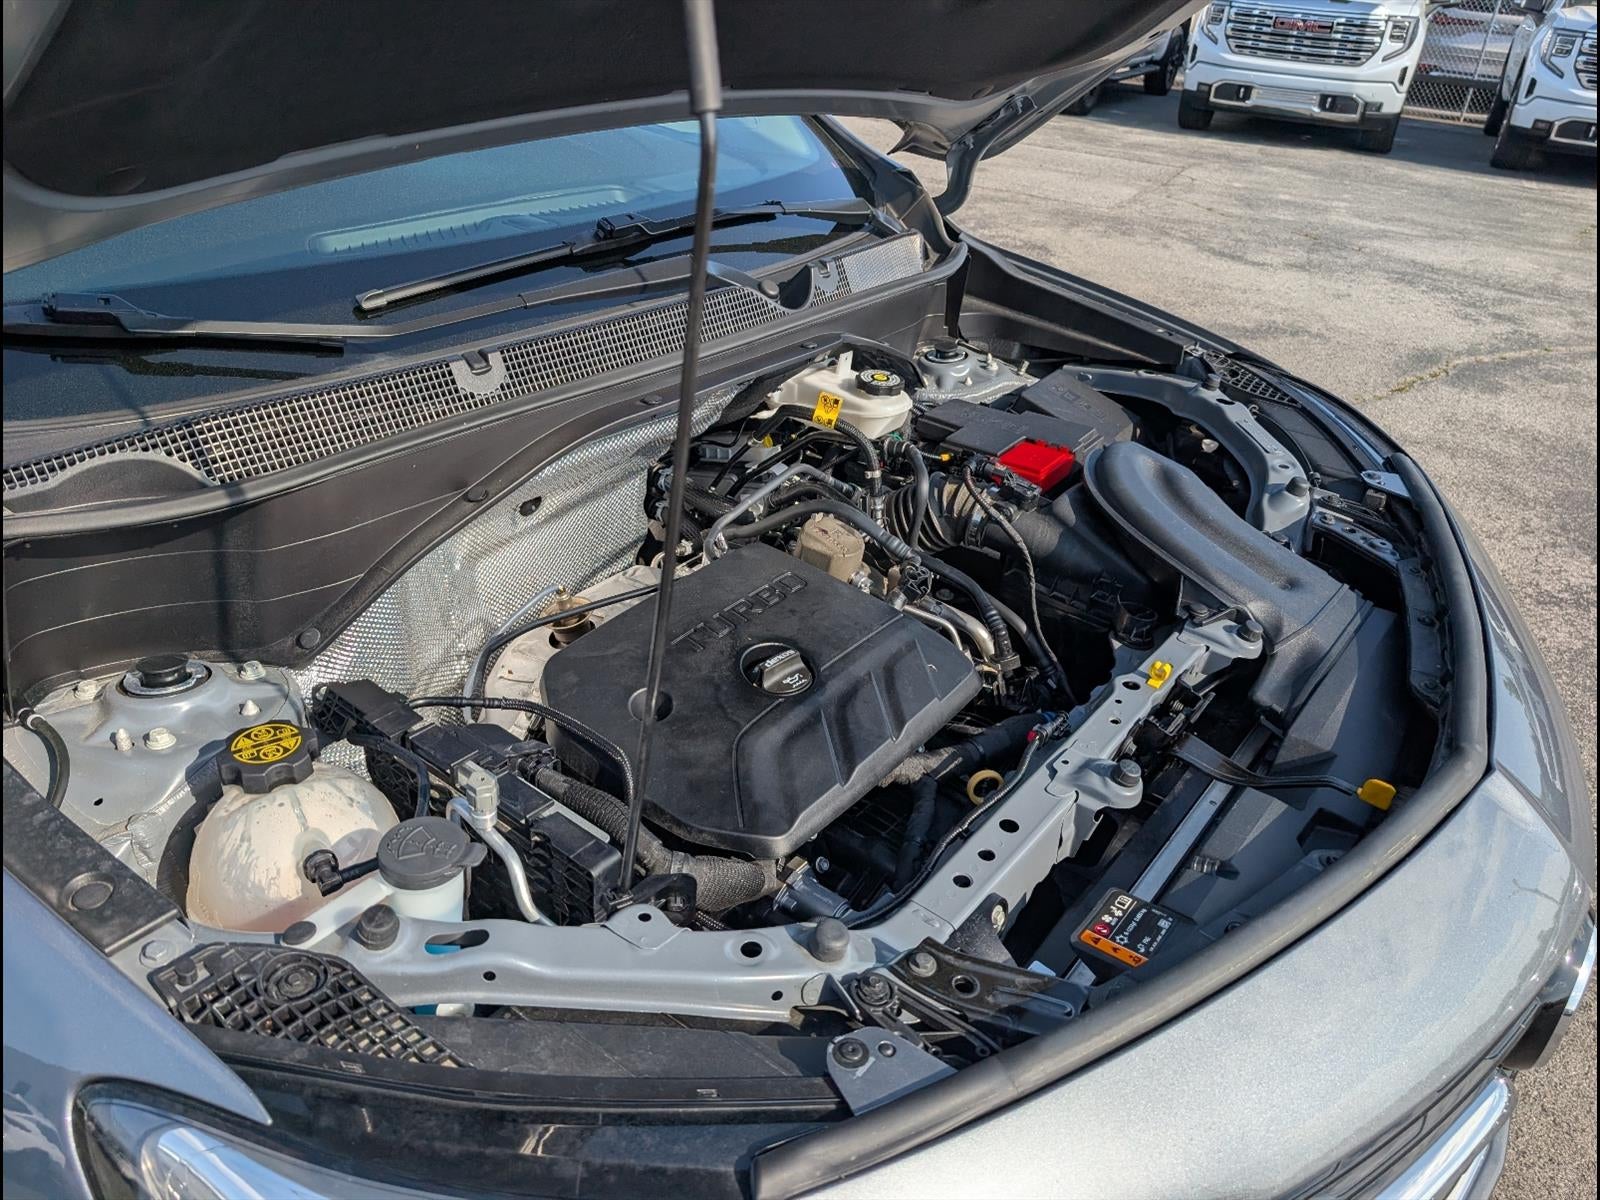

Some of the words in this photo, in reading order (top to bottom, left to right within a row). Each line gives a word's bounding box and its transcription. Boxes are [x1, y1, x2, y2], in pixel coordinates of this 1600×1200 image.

[1275, 17, 1332, 33] GMC
[671, 571, 808, 653] TURBO
[764, 649, 796, 668] dexos
